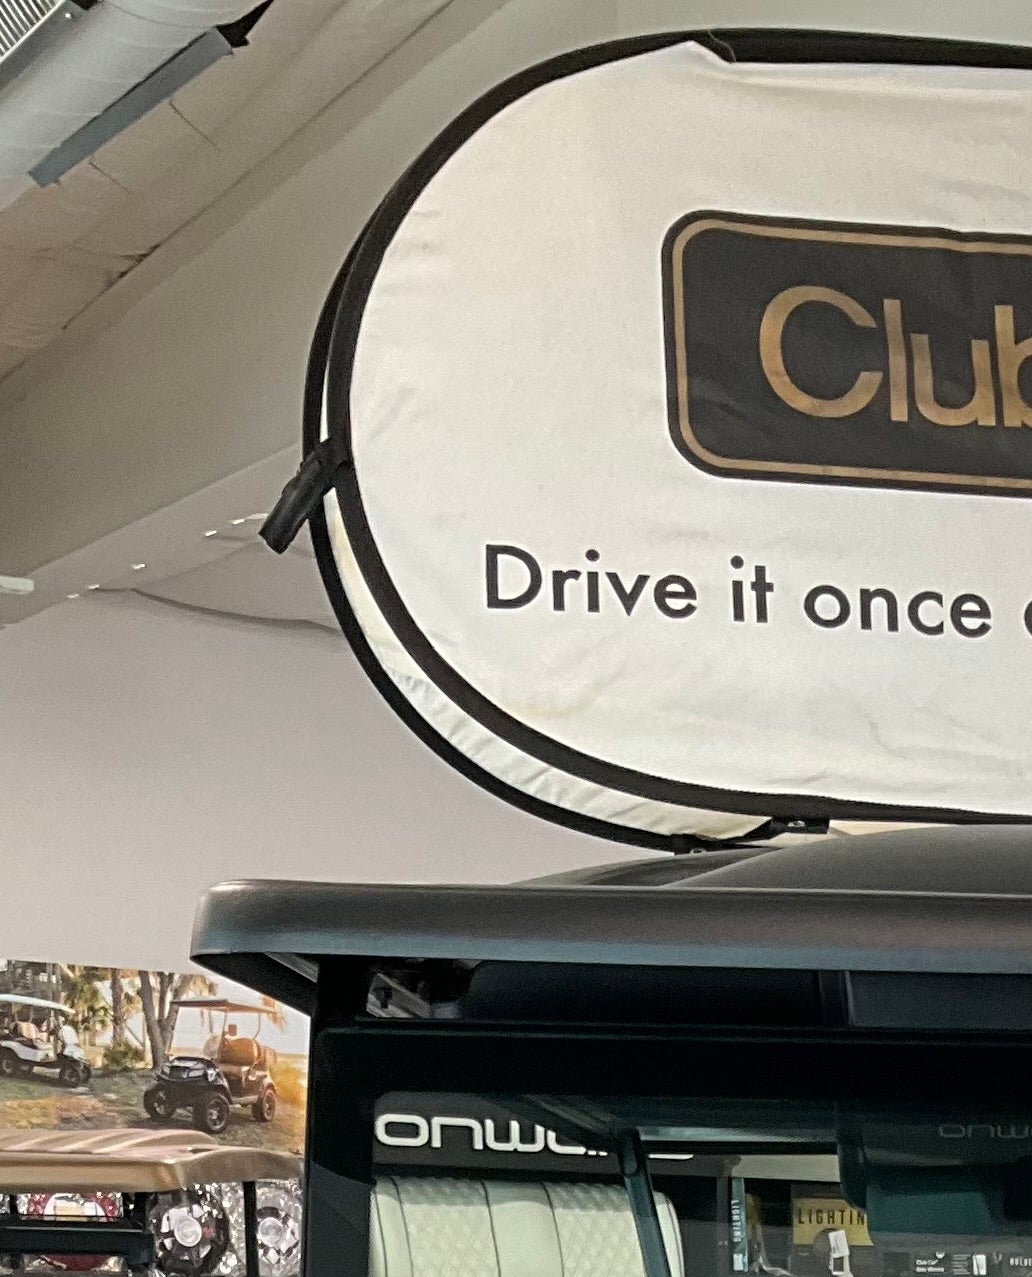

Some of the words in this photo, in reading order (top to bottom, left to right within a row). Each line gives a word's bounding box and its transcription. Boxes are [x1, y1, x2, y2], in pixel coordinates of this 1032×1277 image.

[486, 545, 698, 619] Drive
[730, 556, 773, 623] it
[804, 584, 992, 638] once
[798, 1208, 864, 1225] LIGHTIN
